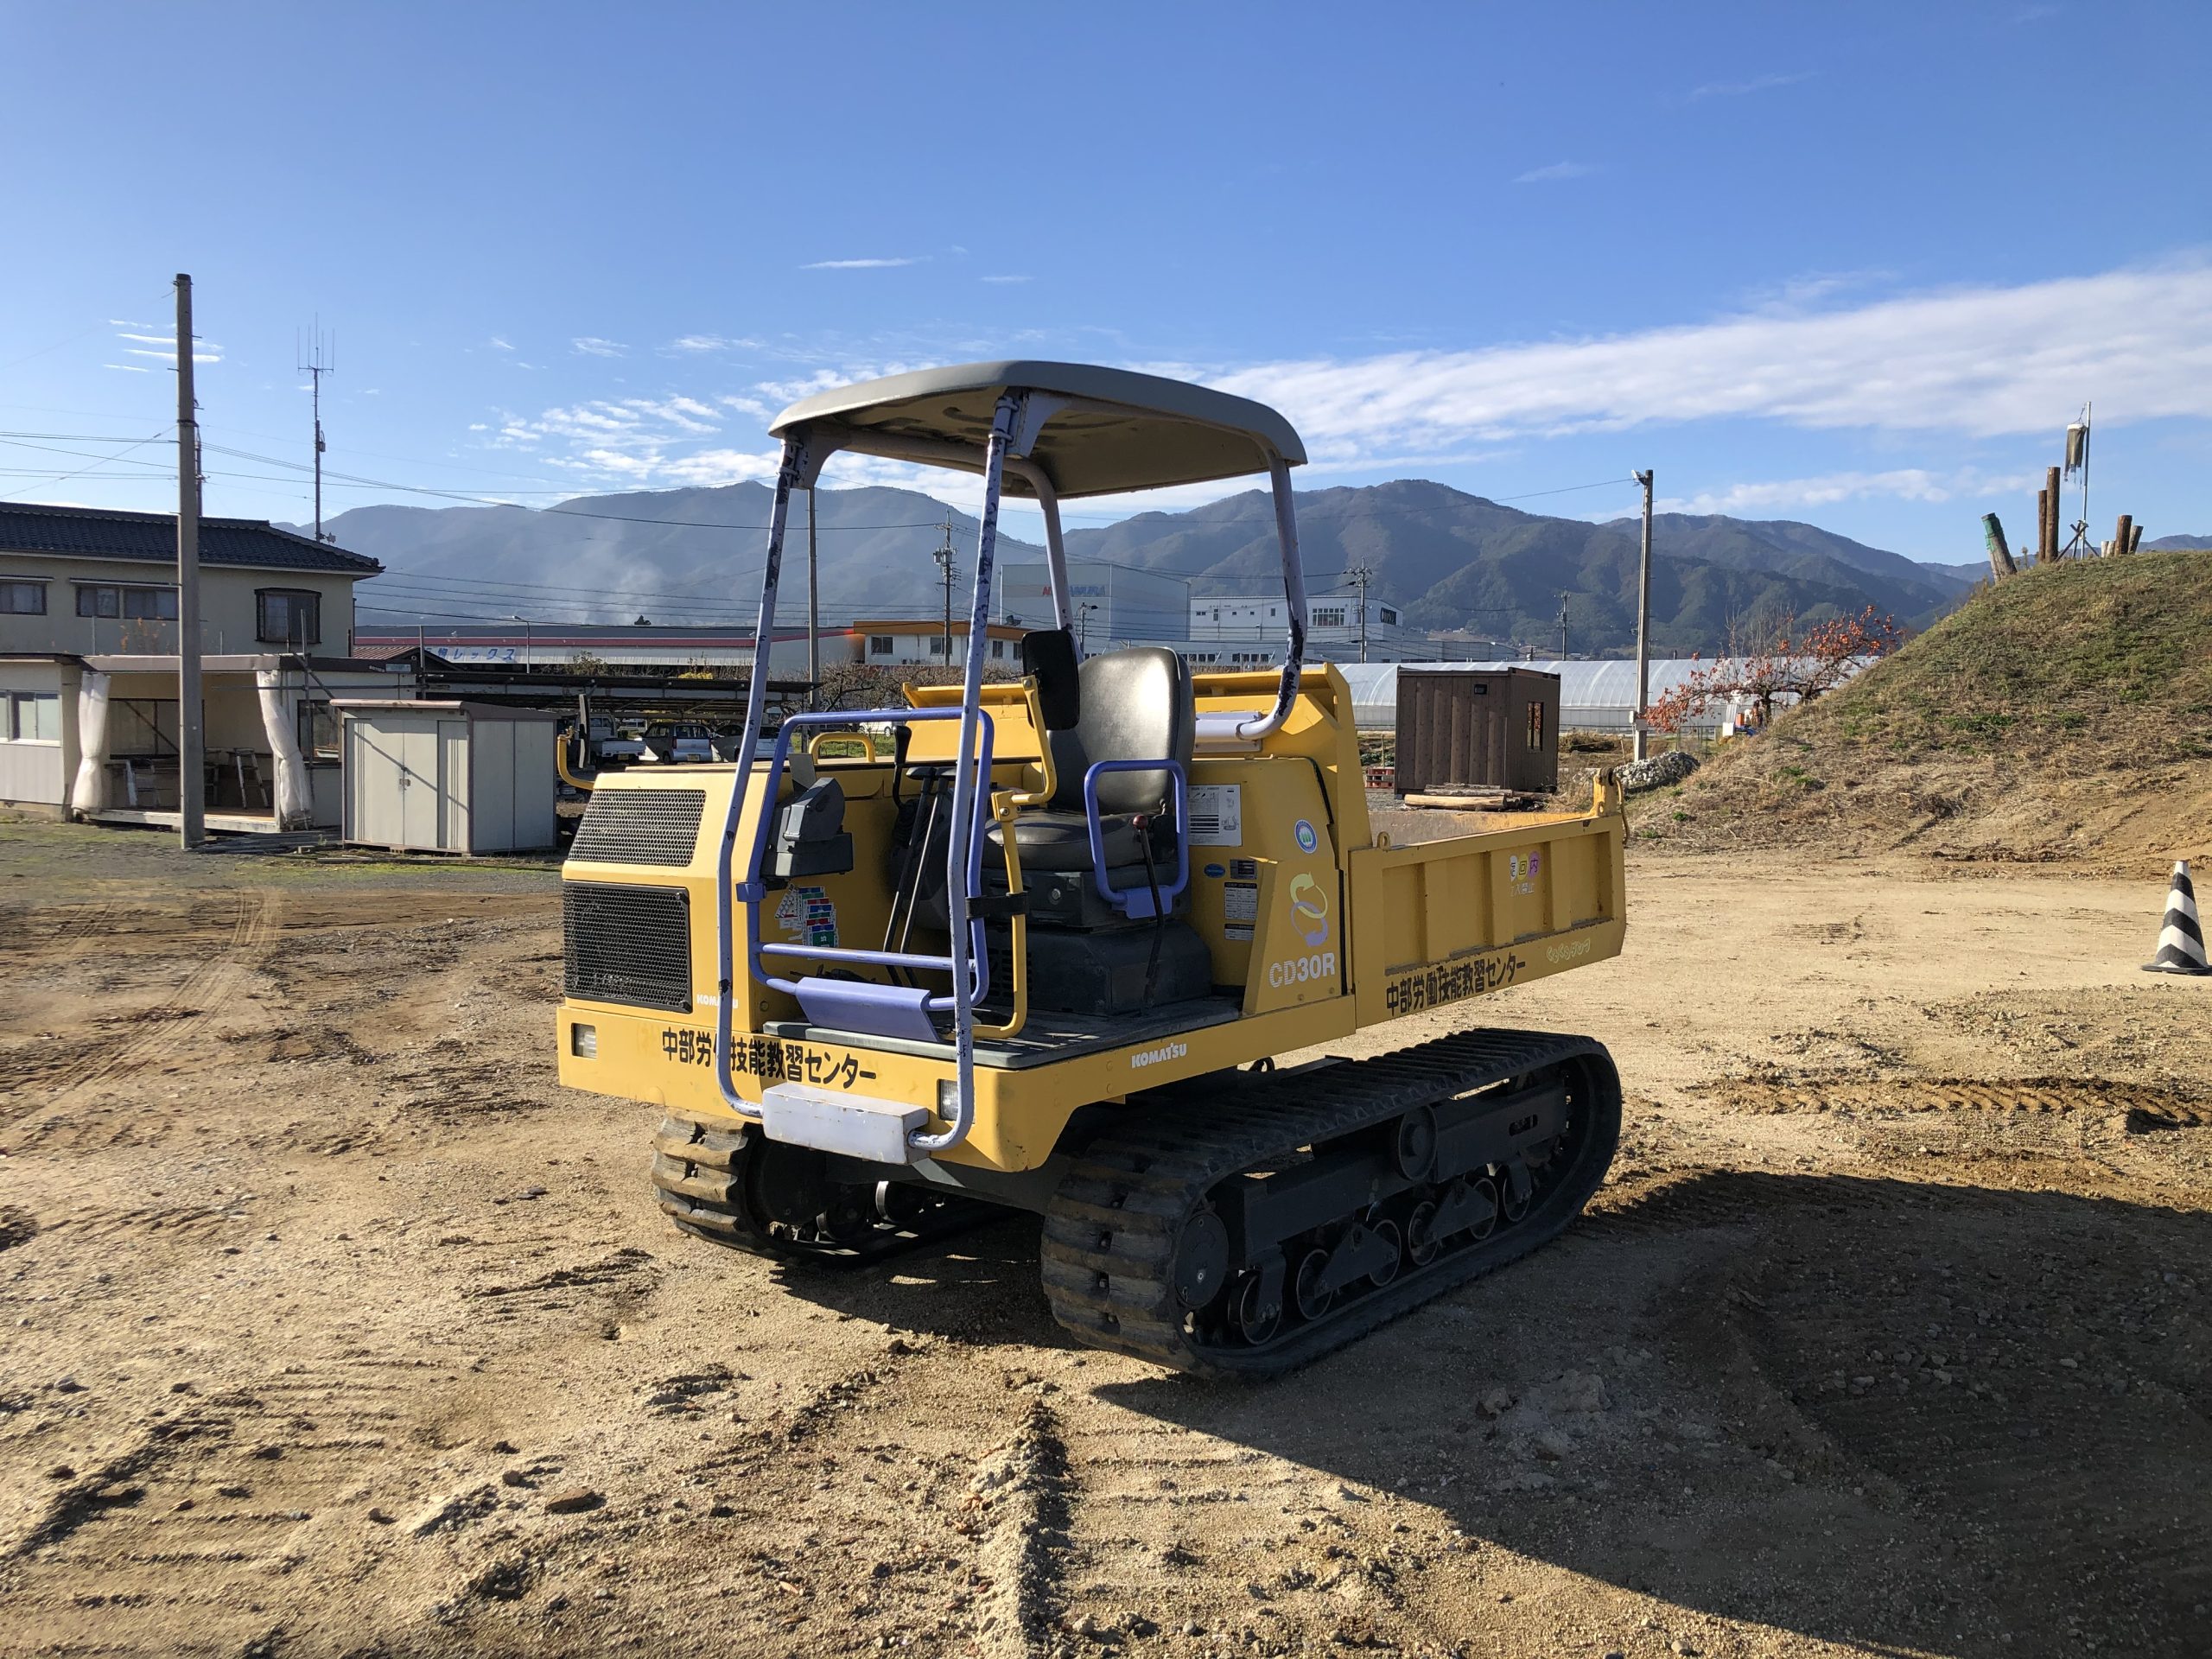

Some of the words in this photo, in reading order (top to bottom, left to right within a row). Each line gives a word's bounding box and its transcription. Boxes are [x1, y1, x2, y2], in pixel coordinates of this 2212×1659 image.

[1268, 952, 1336, 988] CD30R
[1386, 950, 1527, 1017] 中部労働技能教習センター
[696, 994, 739, 1009] KOMU
[662, 1027, 877, 1090] 中部労技能教習センター
[1131, 1042, 1187, 1069] KOMATSU
